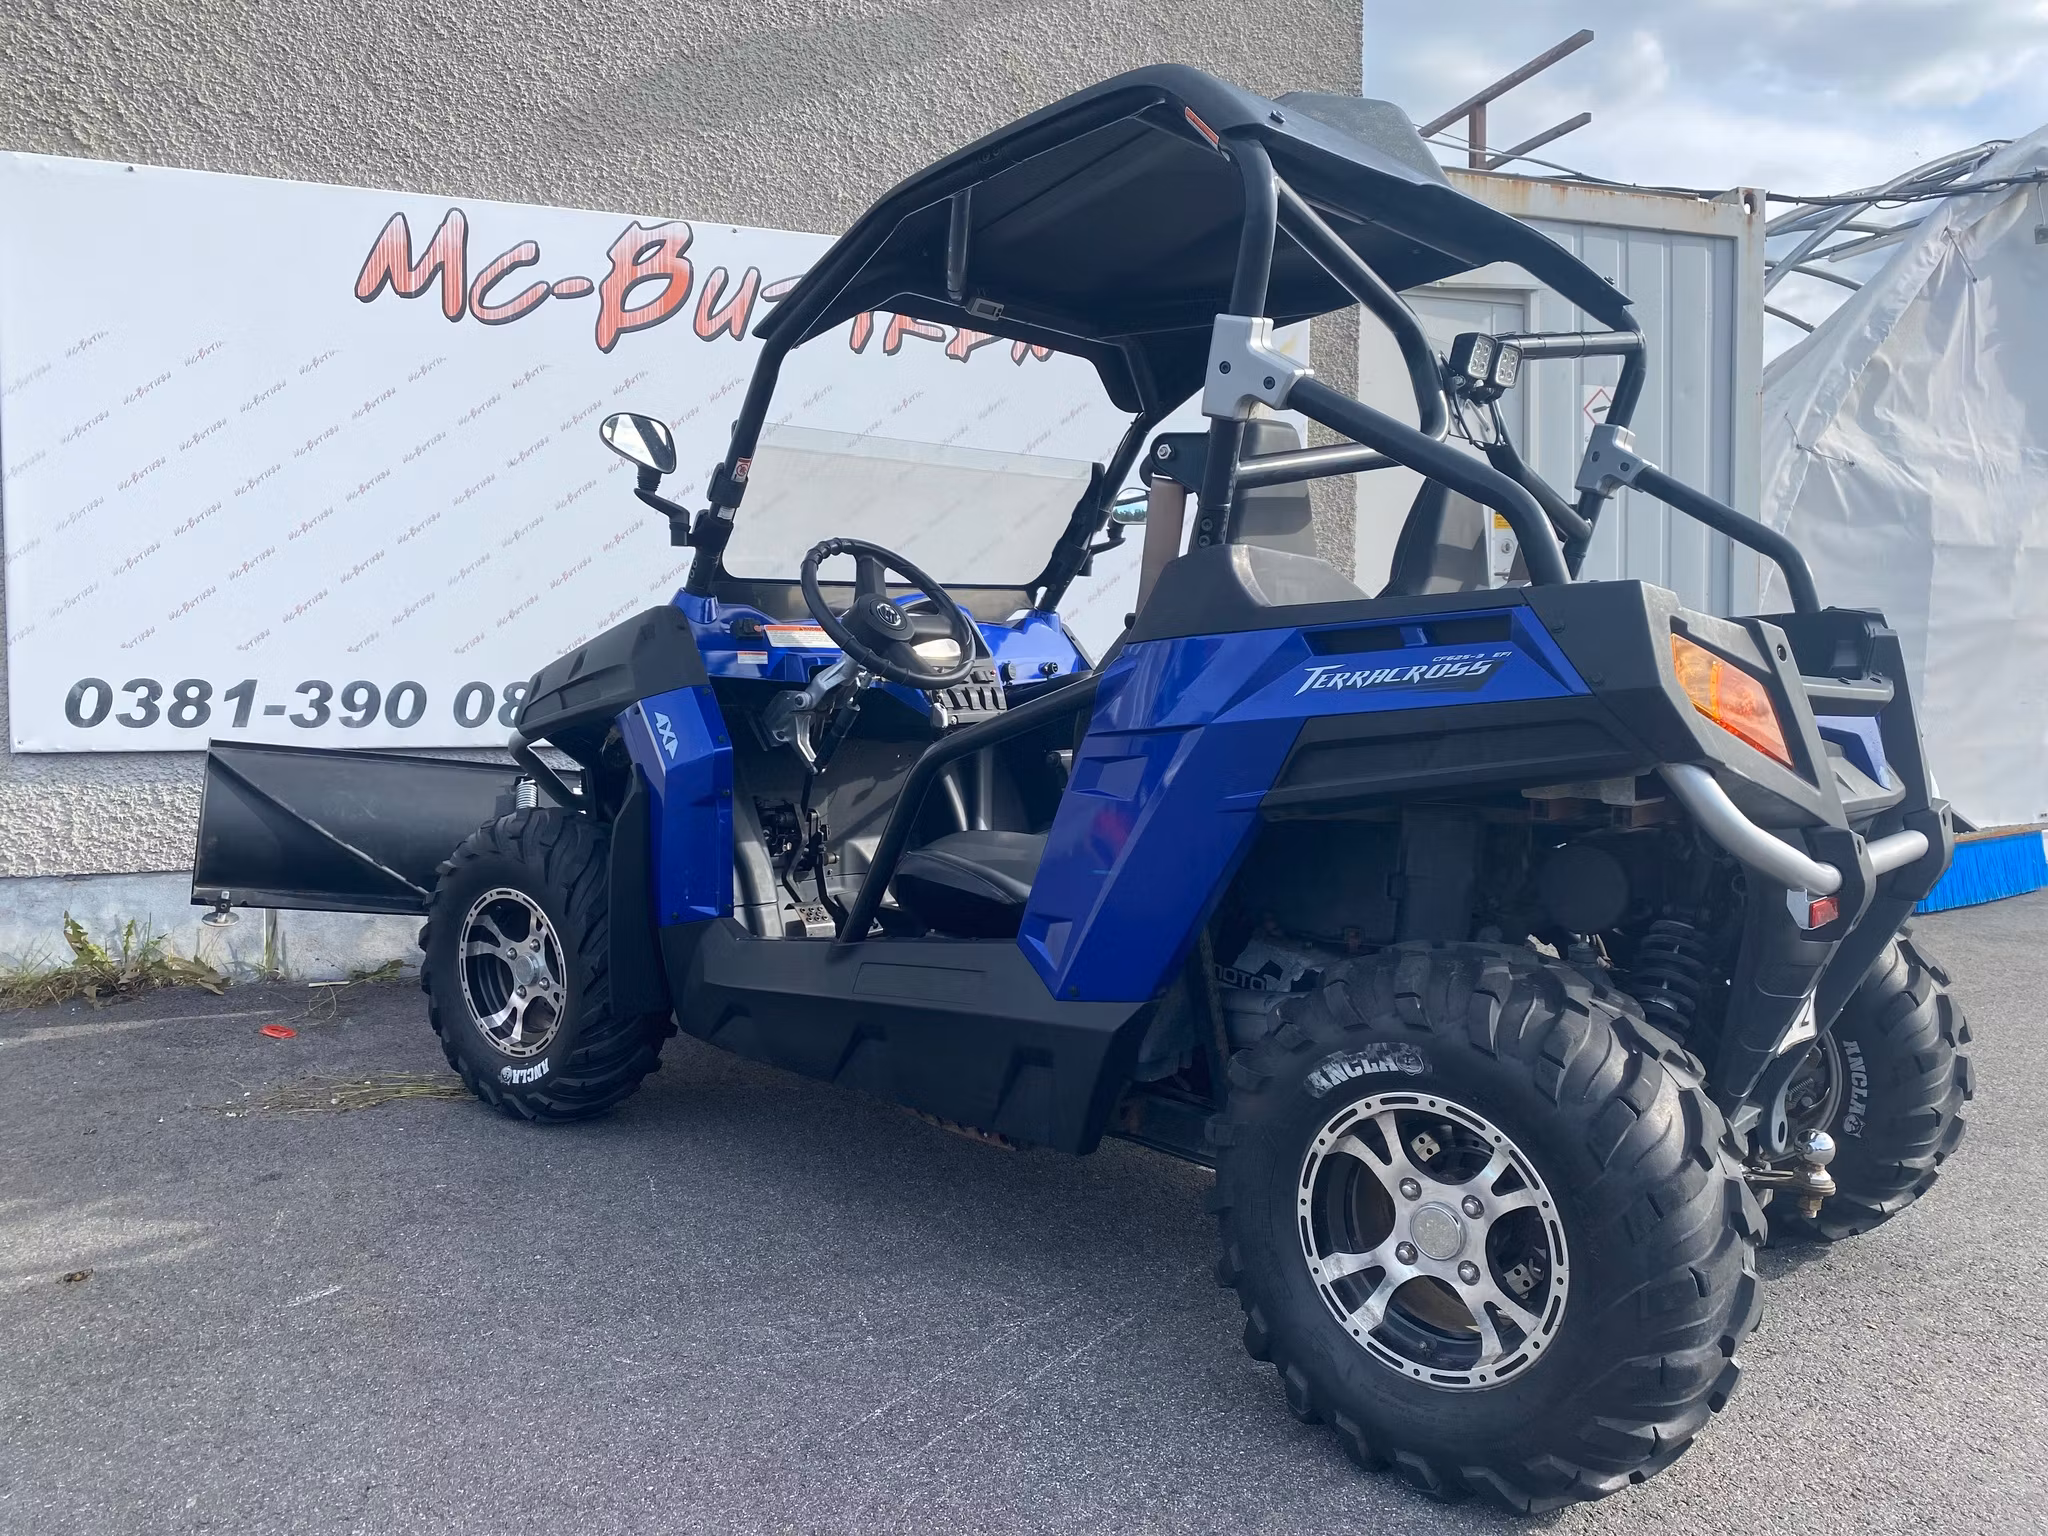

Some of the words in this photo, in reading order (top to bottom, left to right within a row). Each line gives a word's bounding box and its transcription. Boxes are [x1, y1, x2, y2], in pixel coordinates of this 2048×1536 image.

[1294, 659, 1495, 697] TERRACROSS
[64, 677, 428, 729] 0381-390
[512, 1057, 550, 1084] ANCLA
[1306, 1053, 1400, 1091] ANCLA
[1842, 1040, 1868, 1116] ANCLA
